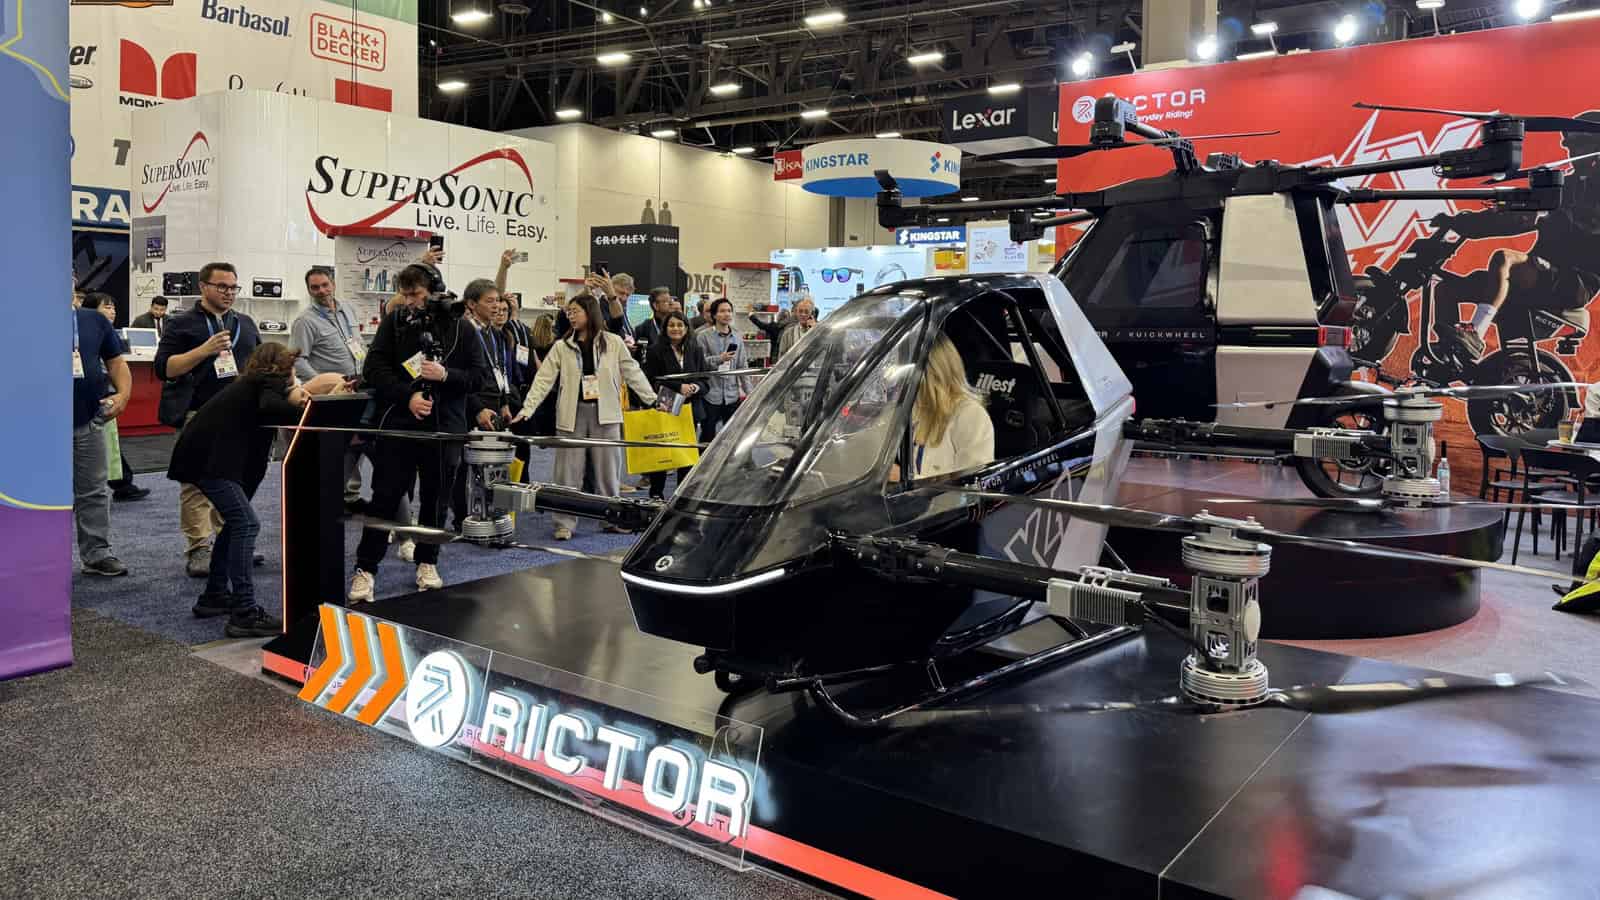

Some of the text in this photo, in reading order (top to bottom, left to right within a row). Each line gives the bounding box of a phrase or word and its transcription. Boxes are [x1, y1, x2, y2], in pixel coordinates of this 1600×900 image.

[317, 21, 380, 47] BLACK+
[317, 37, 380, 64] DECKER
[952, 107, 1017, 131] Lexar
[805, 152, 870, 173] KINGSTAR
[415, 207, 549, 243] Live. Life. Easy.
[909, 230, 961, 242] KINGSTAR
[593, 234, 648, 246] CROSLEY
[976, 373, 1017, 394] illest
[480, 689, 750, 837] RICTOR
